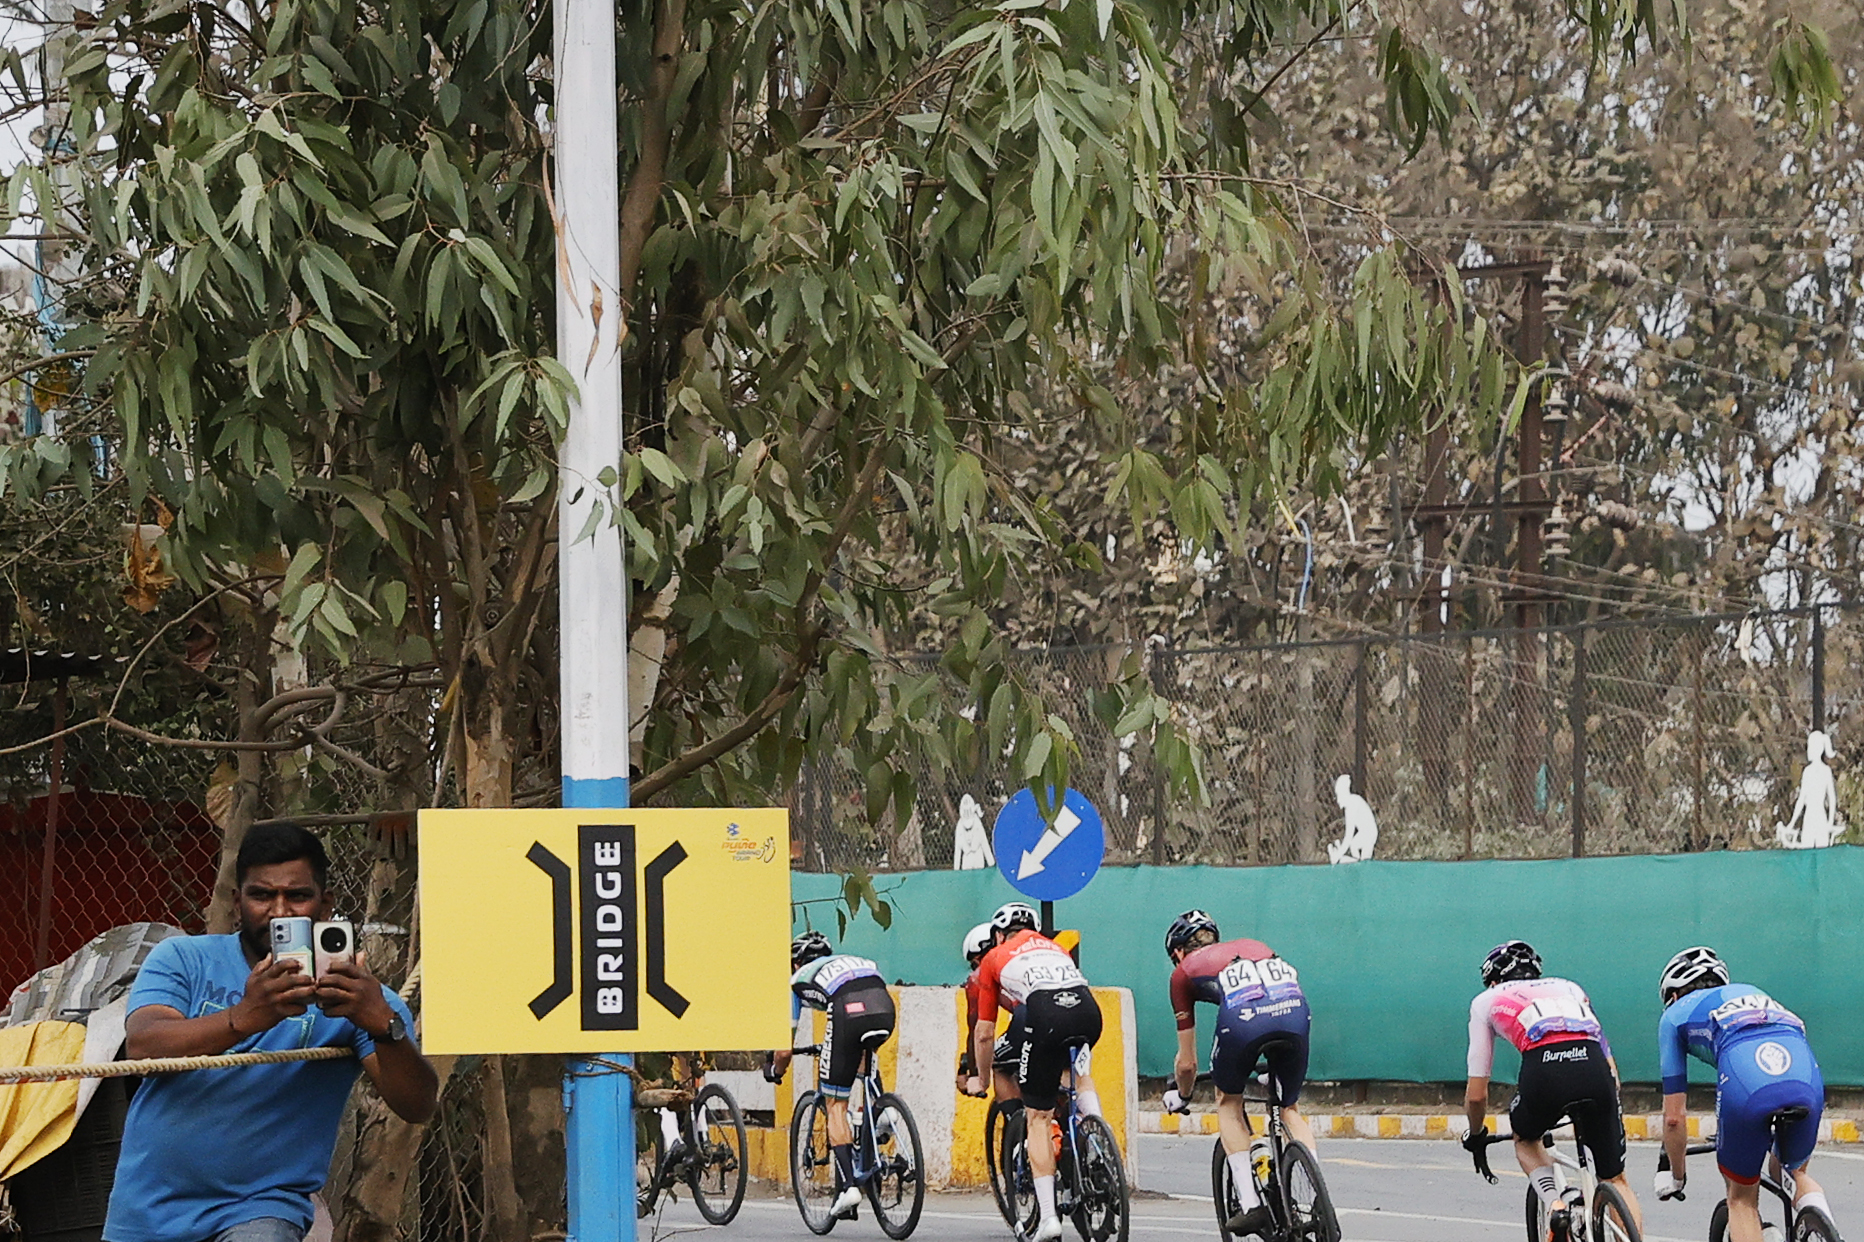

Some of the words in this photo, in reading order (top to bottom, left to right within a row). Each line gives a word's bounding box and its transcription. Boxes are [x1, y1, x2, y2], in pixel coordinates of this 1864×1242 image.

[594, 841, 624, 1014] BRIDGE
[820, 961, 844, 981] 175
[1056, 965, 1079, 981] 25
[1226, 963, 1251, 988] 64
[1266, 961, 1292, 981] 64
[1542, 1046, 1588, 1062] Burpellet
